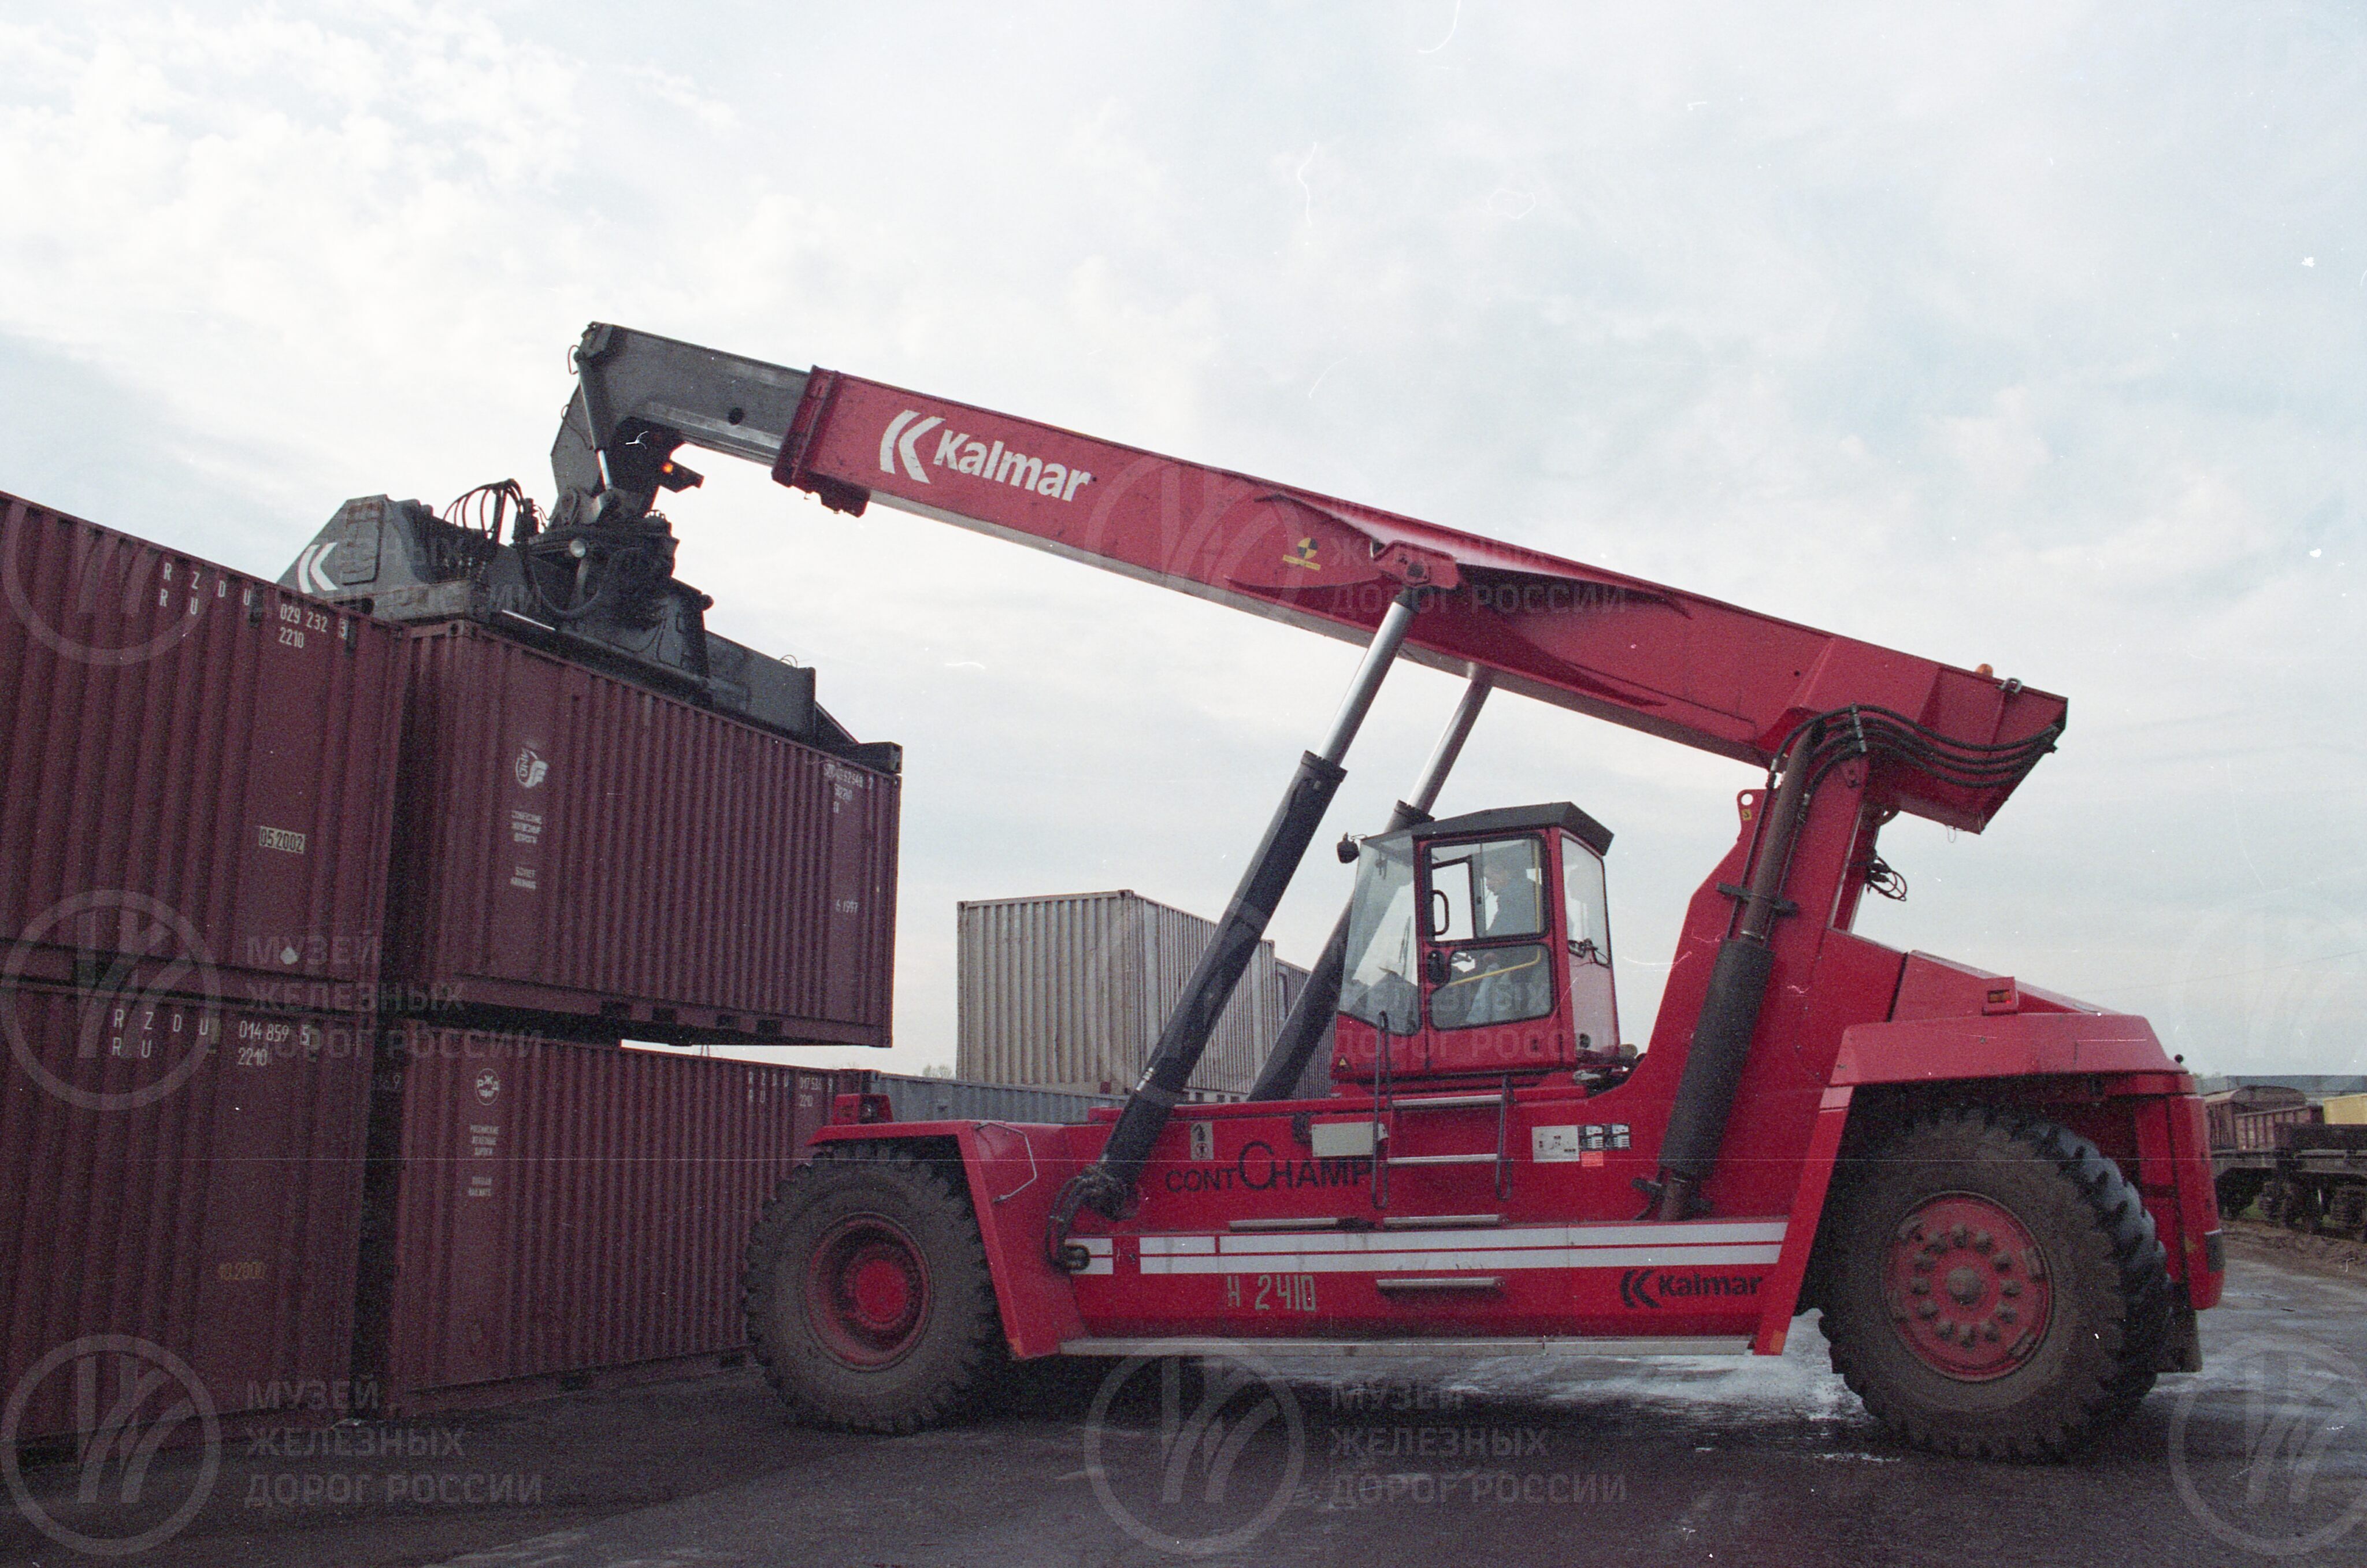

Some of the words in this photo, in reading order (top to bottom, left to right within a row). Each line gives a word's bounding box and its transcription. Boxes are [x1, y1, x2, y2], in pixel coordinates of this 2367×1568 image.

[933, 429, 1092, 502] Kalmar
[280, 604, 300, 624] 029
[306, 611, 328, 633] 232
[279, 627, 305, 649] 2210
[239, 1020, 260, 1039] 014
[1255, 1274, 1316, 1311] 2410
[1659, 1272, 1763, 1296] Kalmar
